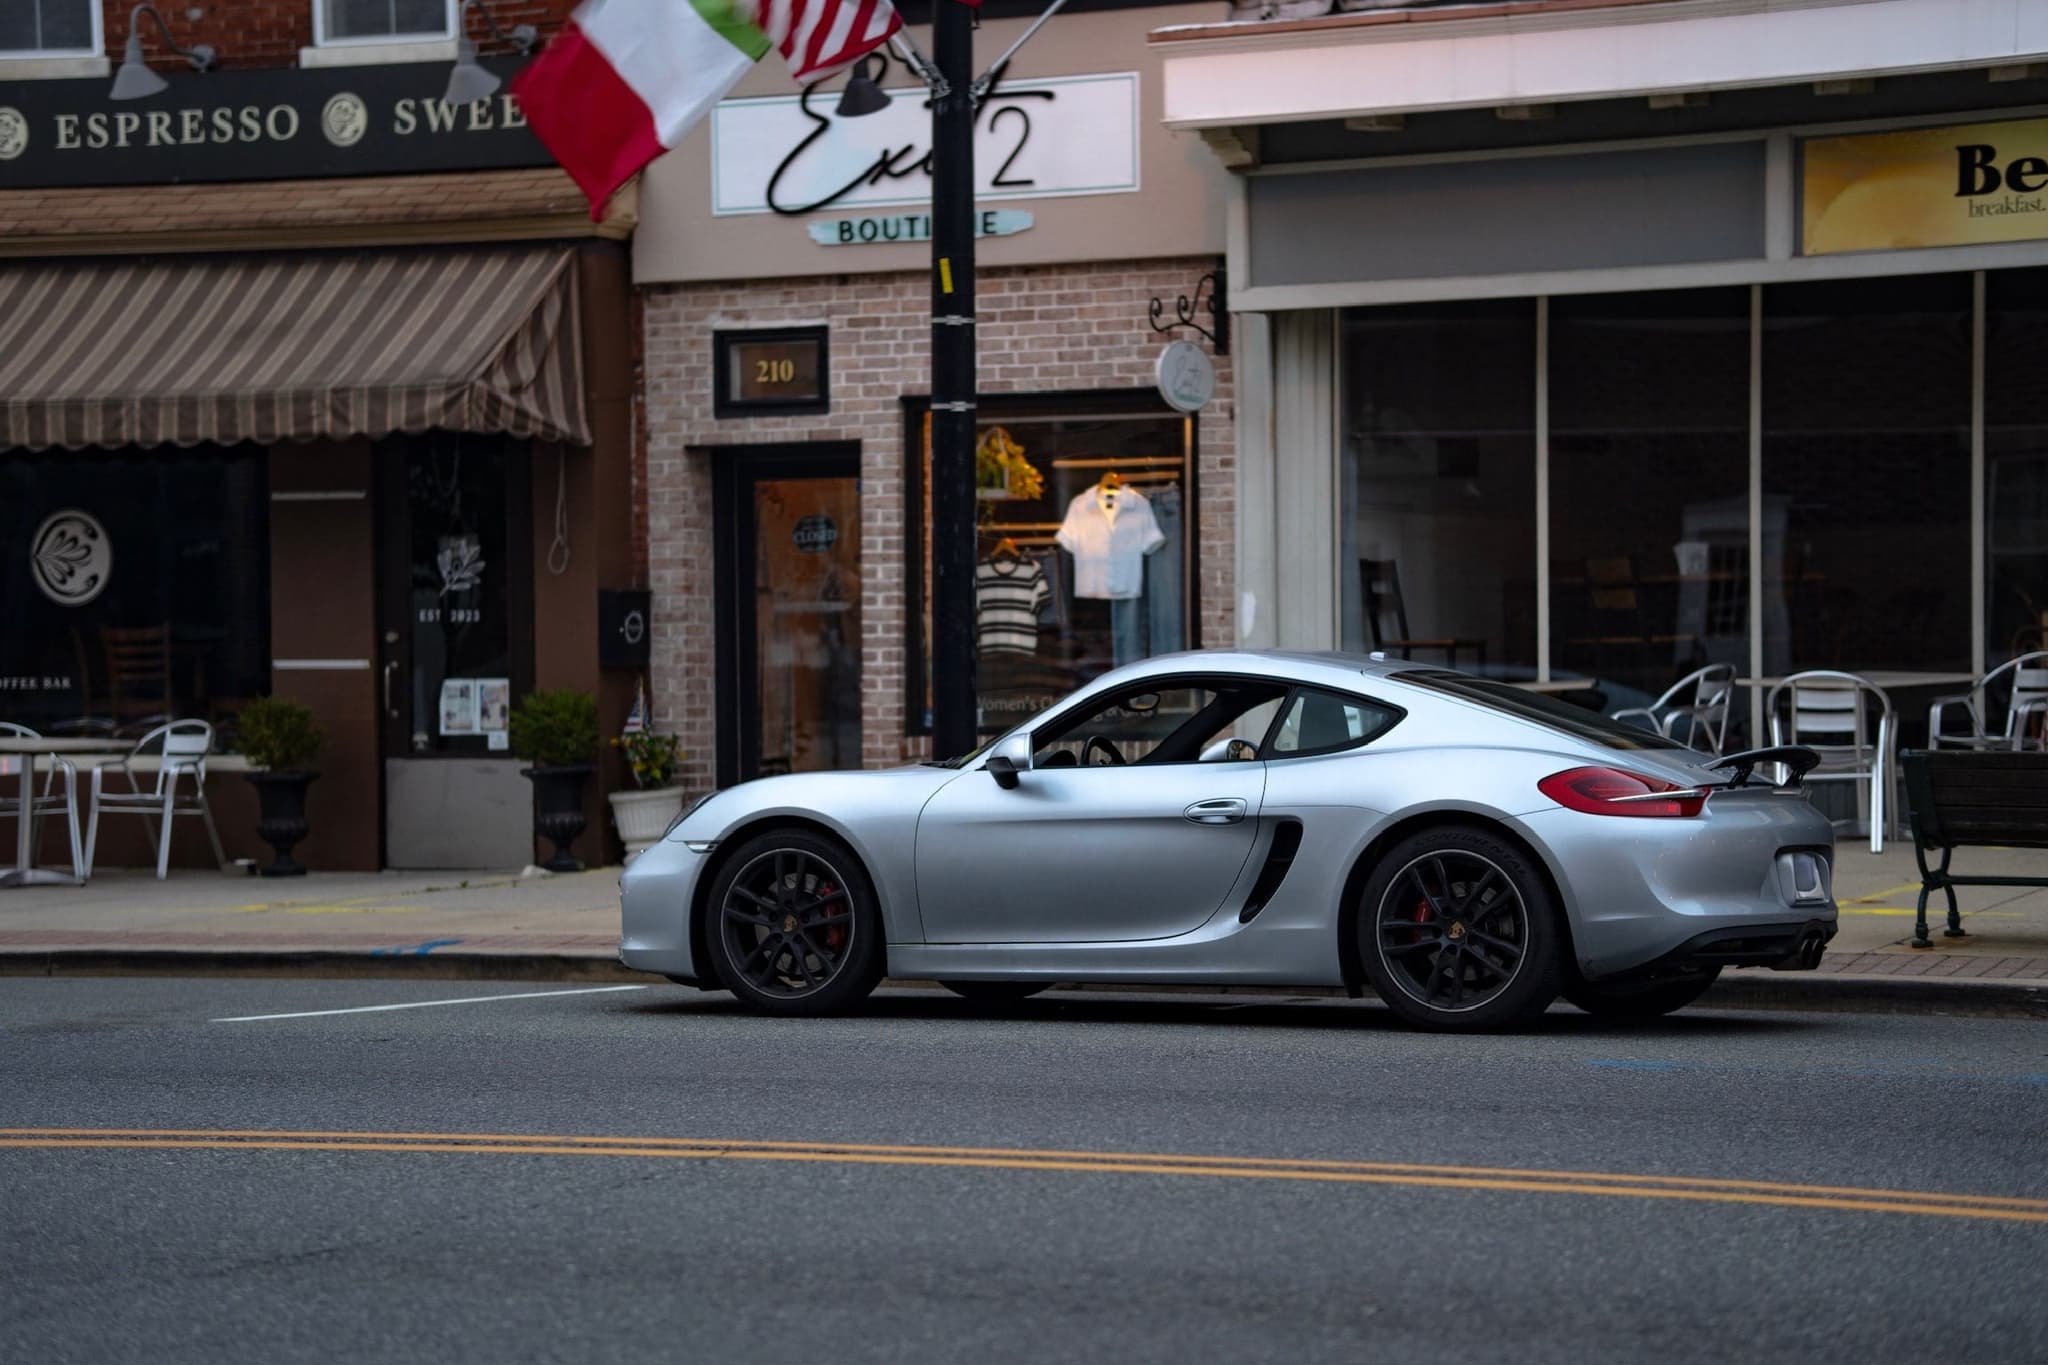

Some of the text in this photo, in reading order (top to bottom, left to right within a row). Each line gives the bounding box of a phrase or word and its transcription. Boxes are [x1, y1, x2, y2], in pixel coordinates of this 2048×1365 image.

[53, 104, 300, 149] ESPRESSO
[988, 105, 1034, 187] 2
[1954, 144, 2048, 197] Be
[839, 211, 998, 242] BOUTIE
[756, 359, 795, 383] 210
[793, 528, 838, 544] CLOSED
[43, 676, 72, 690] BAR
